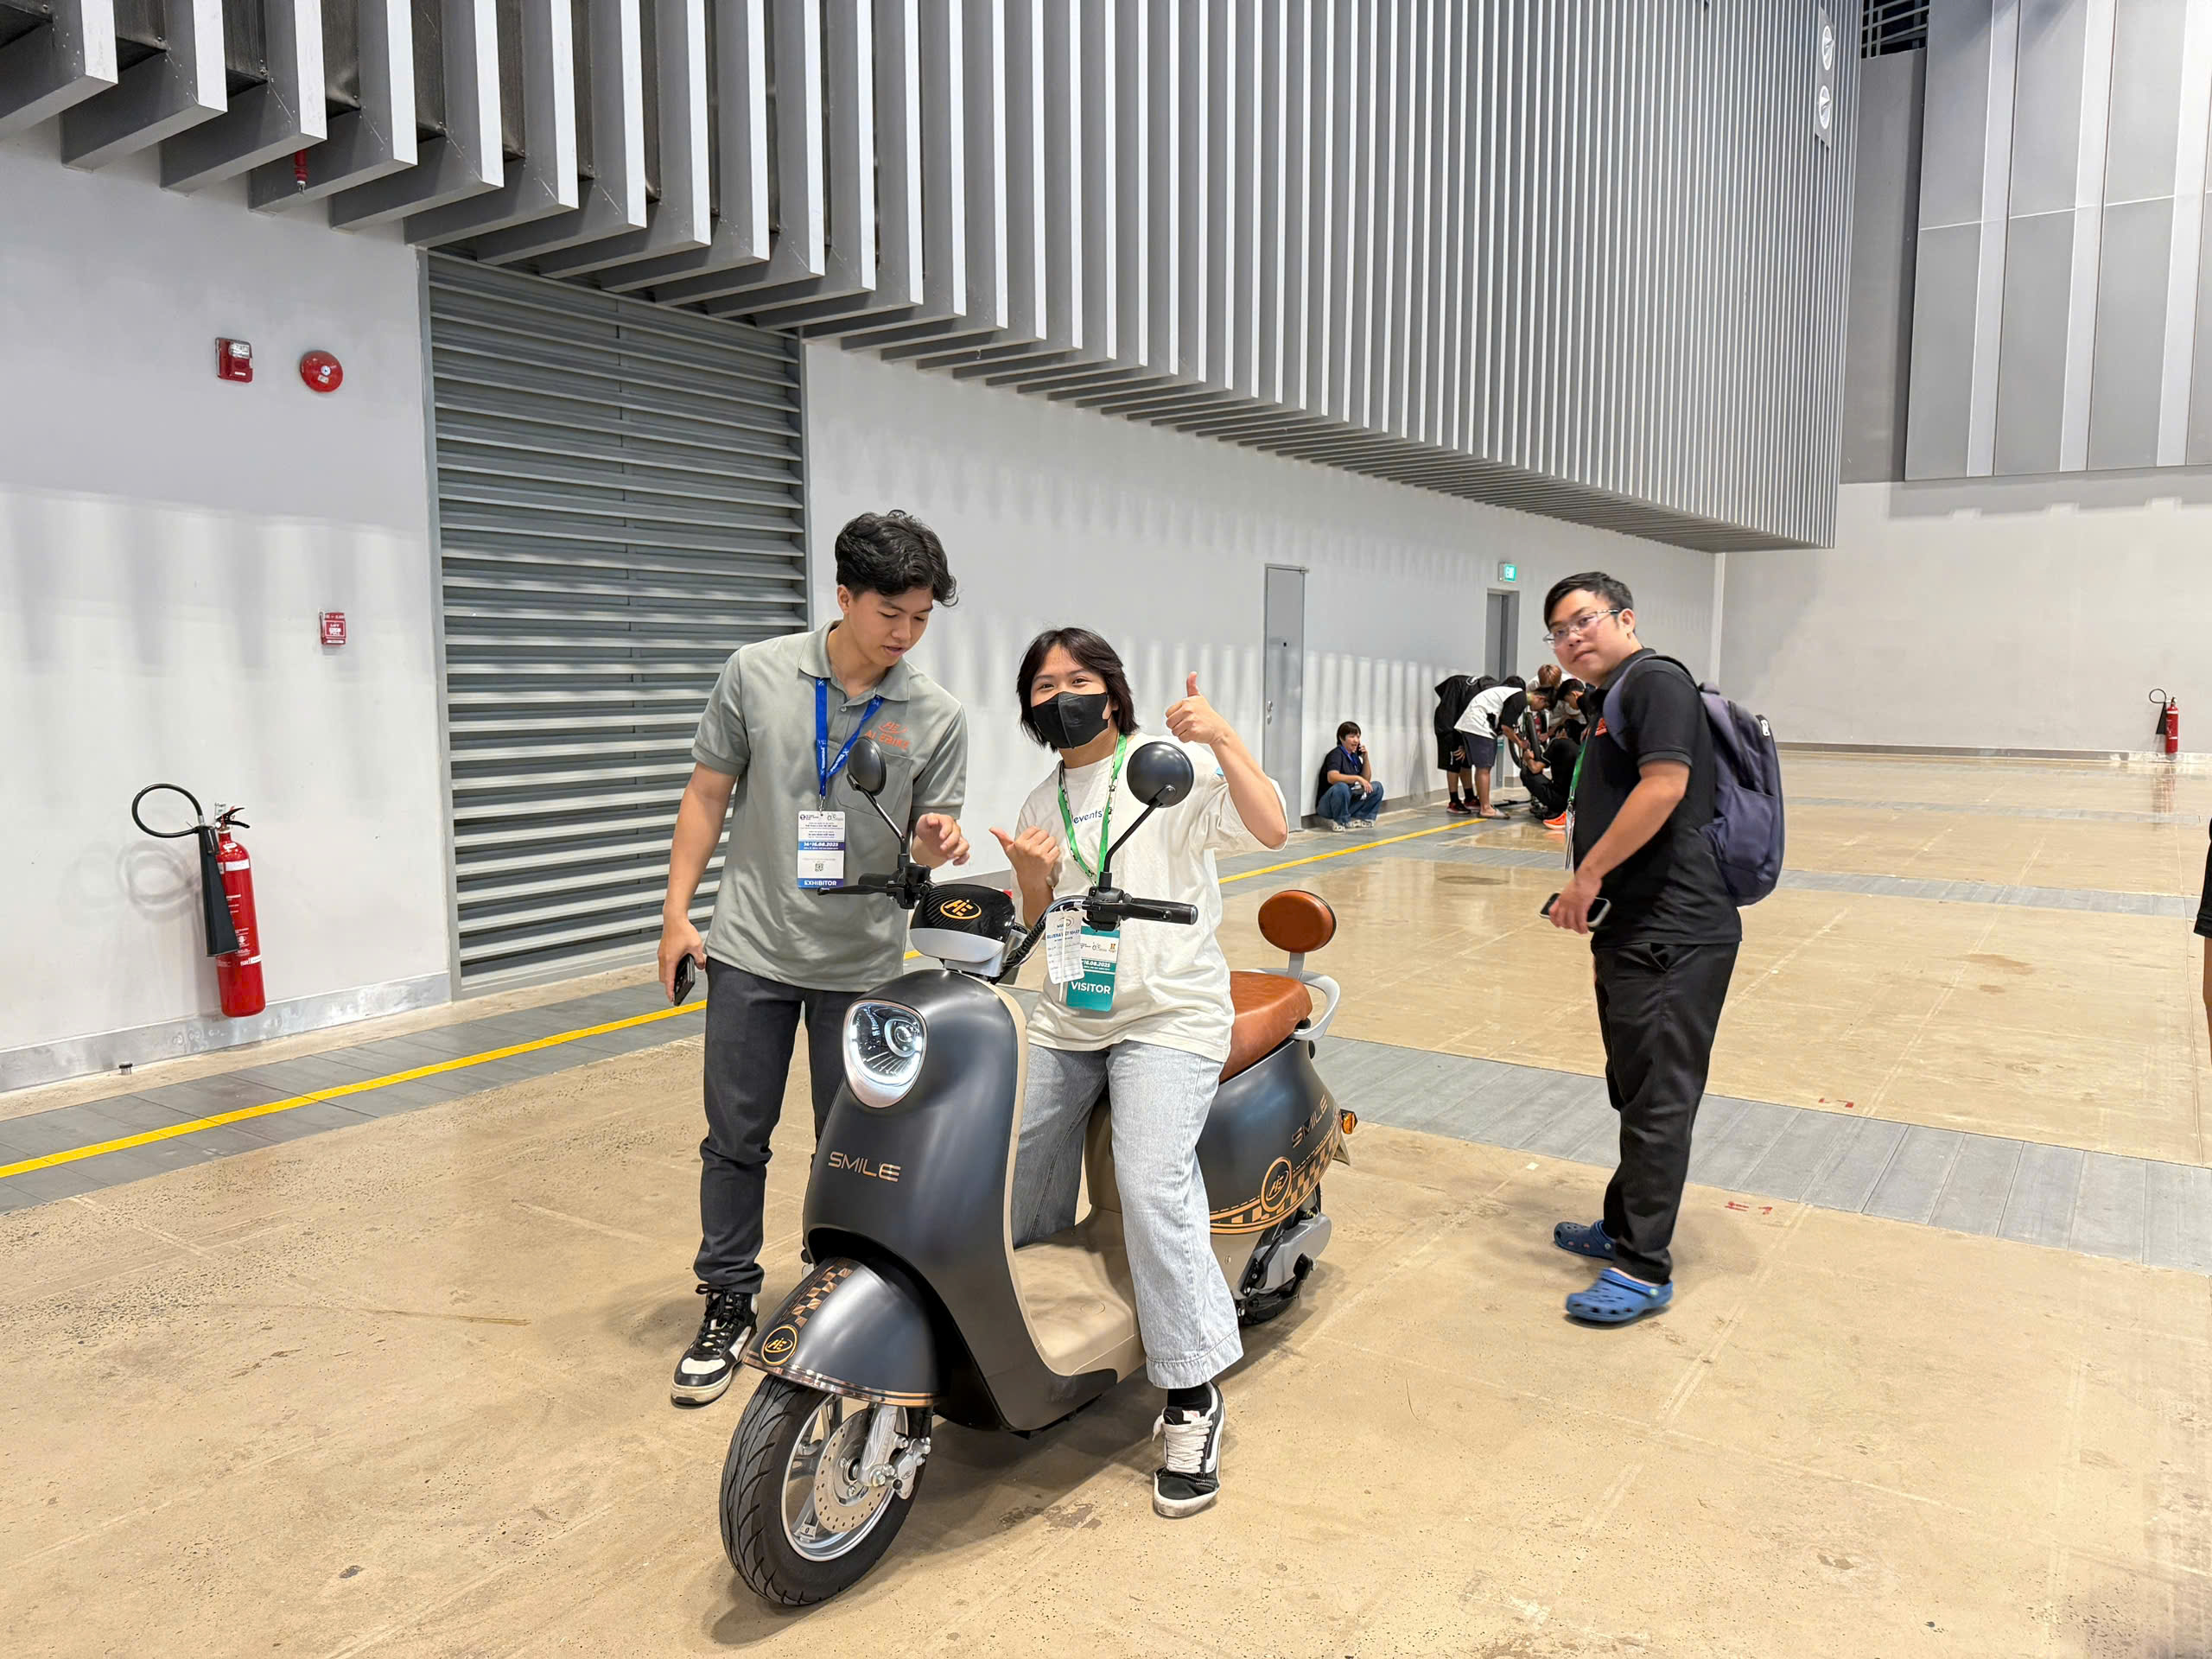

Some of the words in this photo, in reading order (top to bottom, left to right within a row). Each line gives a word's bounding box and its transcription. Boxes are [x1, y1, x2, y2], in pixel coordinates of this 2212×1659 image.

[1073, 810, 1103, 824] events
[1070, 981, 1111, 995] VISITOR
[1291, 1094, 1328, 1148] SMILE
[828, 1151, 901, 1182] SMILE
